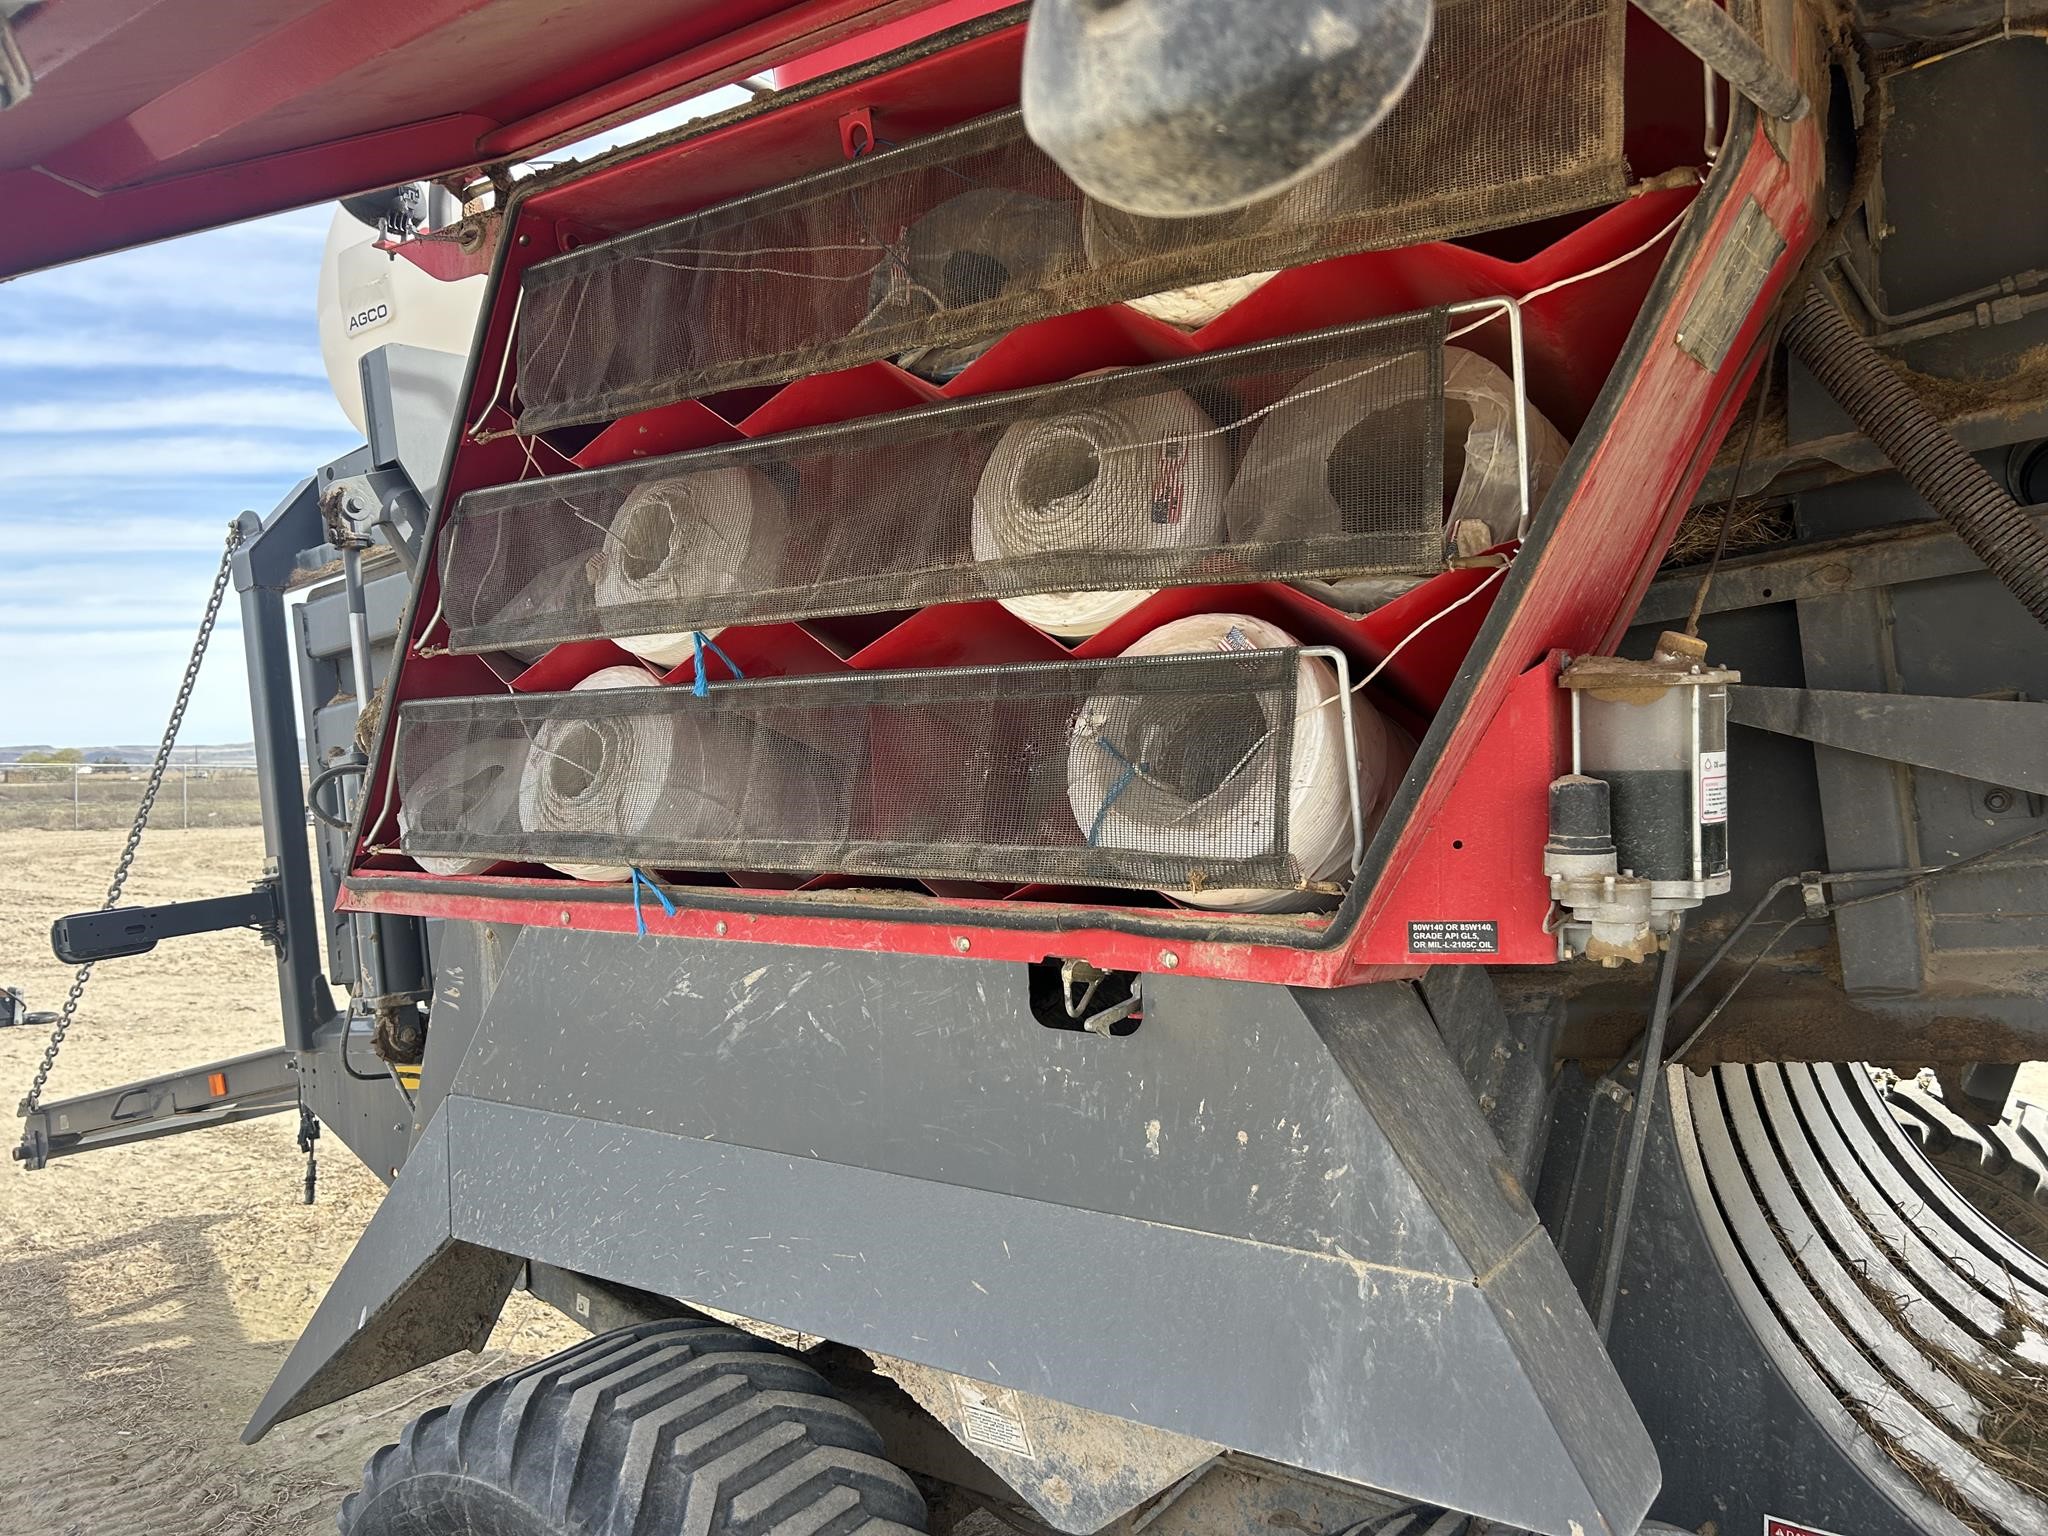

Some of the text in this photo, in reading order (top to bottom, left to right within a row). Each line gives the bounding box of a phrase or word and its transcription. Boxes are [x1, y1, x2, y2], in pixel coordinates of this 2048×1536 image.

[349, 304, 387, 331] AGCO
[1413, 932, 1443, 940] GRADE
[1444, 932, 1459, 940] API
